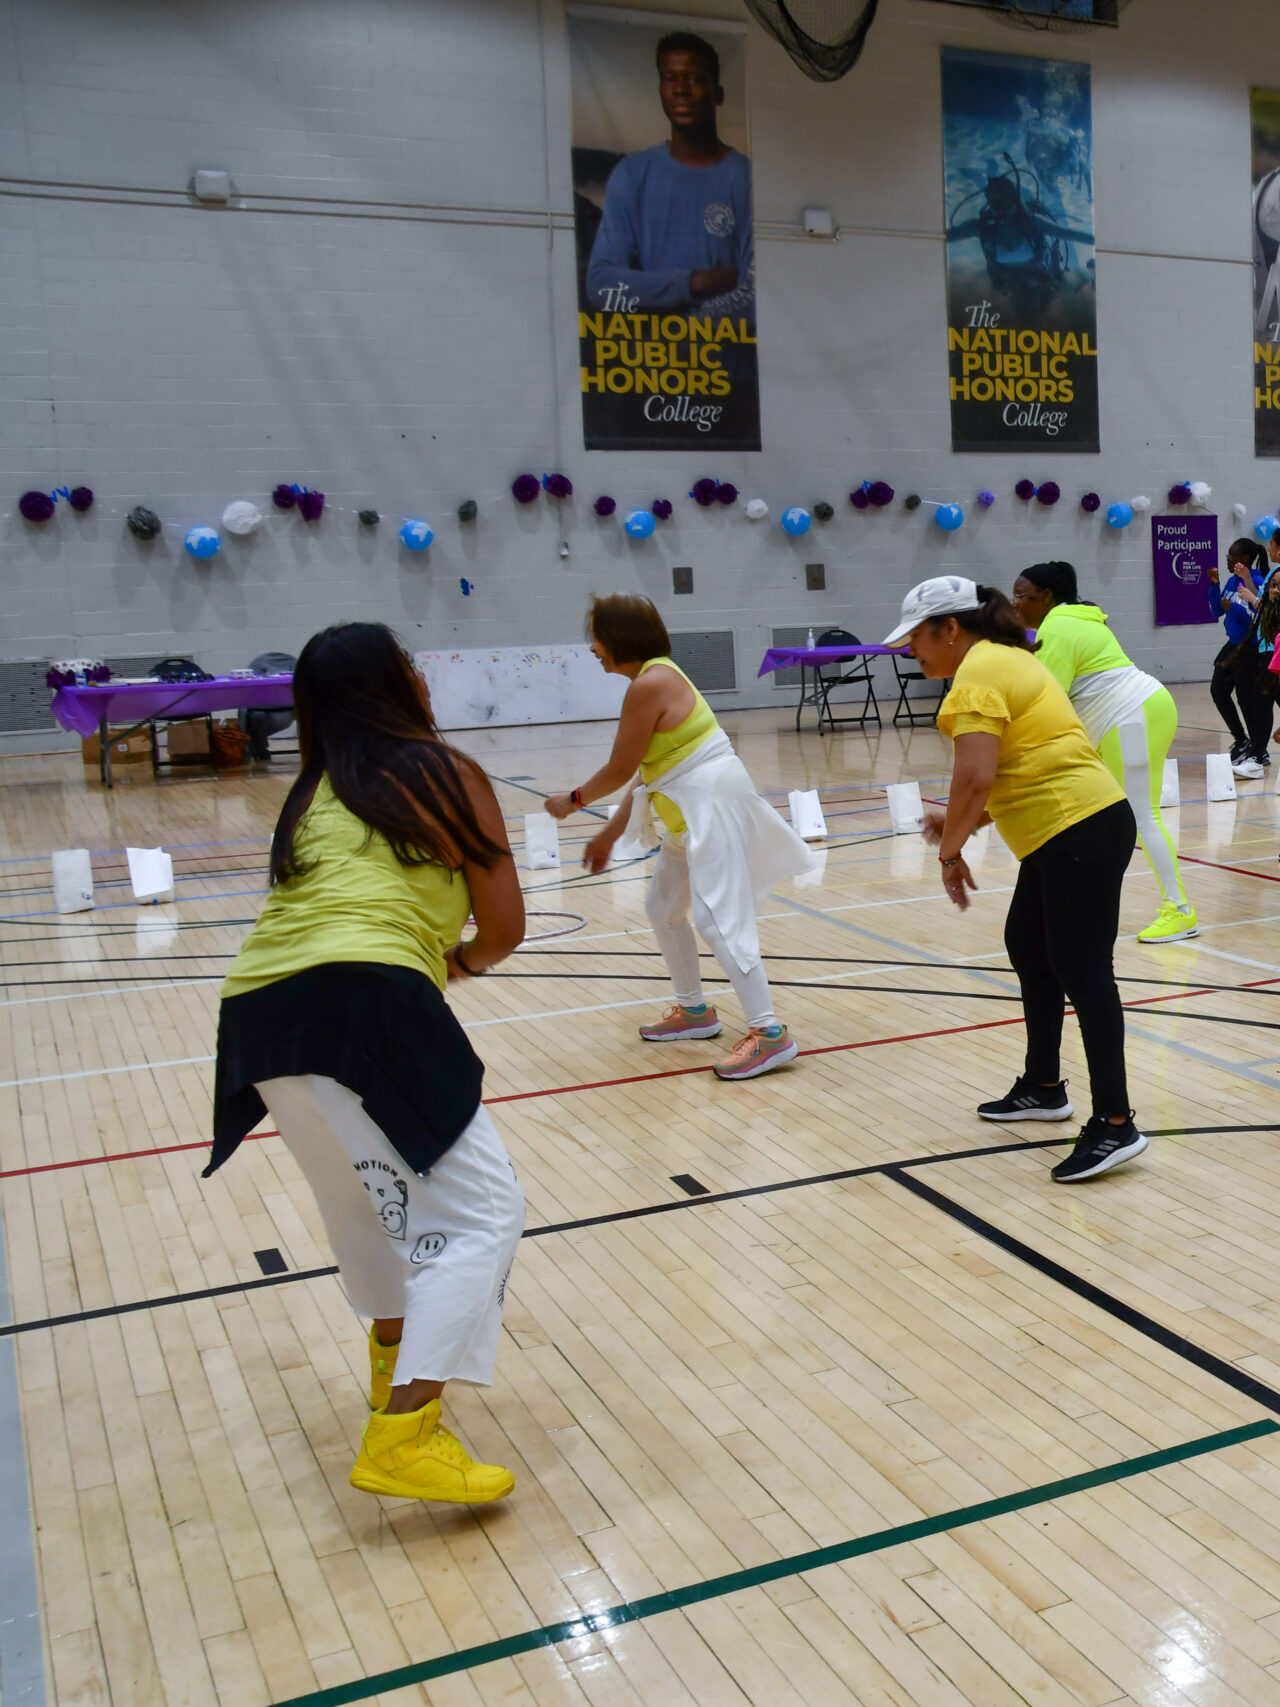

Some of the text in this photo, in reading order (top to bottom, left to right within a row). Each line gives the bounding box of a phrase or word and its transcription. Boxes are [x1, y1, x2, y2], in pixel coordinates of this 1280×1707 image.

[598, 282, 640, 313] The
[578, 312, 757, 344] NATIONAL
[965, 301, 1000, 328] The
[596, 340, 722, 369] PUBLIC
[948, 327, 1097, 356] NATIONAL
[963, 352, 1068, 379] PUBLIC
[580, 367, 731, 396] HONORS
[950, 376, 1074, 403] HONORS
[644, 395, 722, 432] College
[1003, 402, 1067, 435] College
[1158, 524, 1187, 534] Proud
[1158, 539, 1211, 552] Participant
